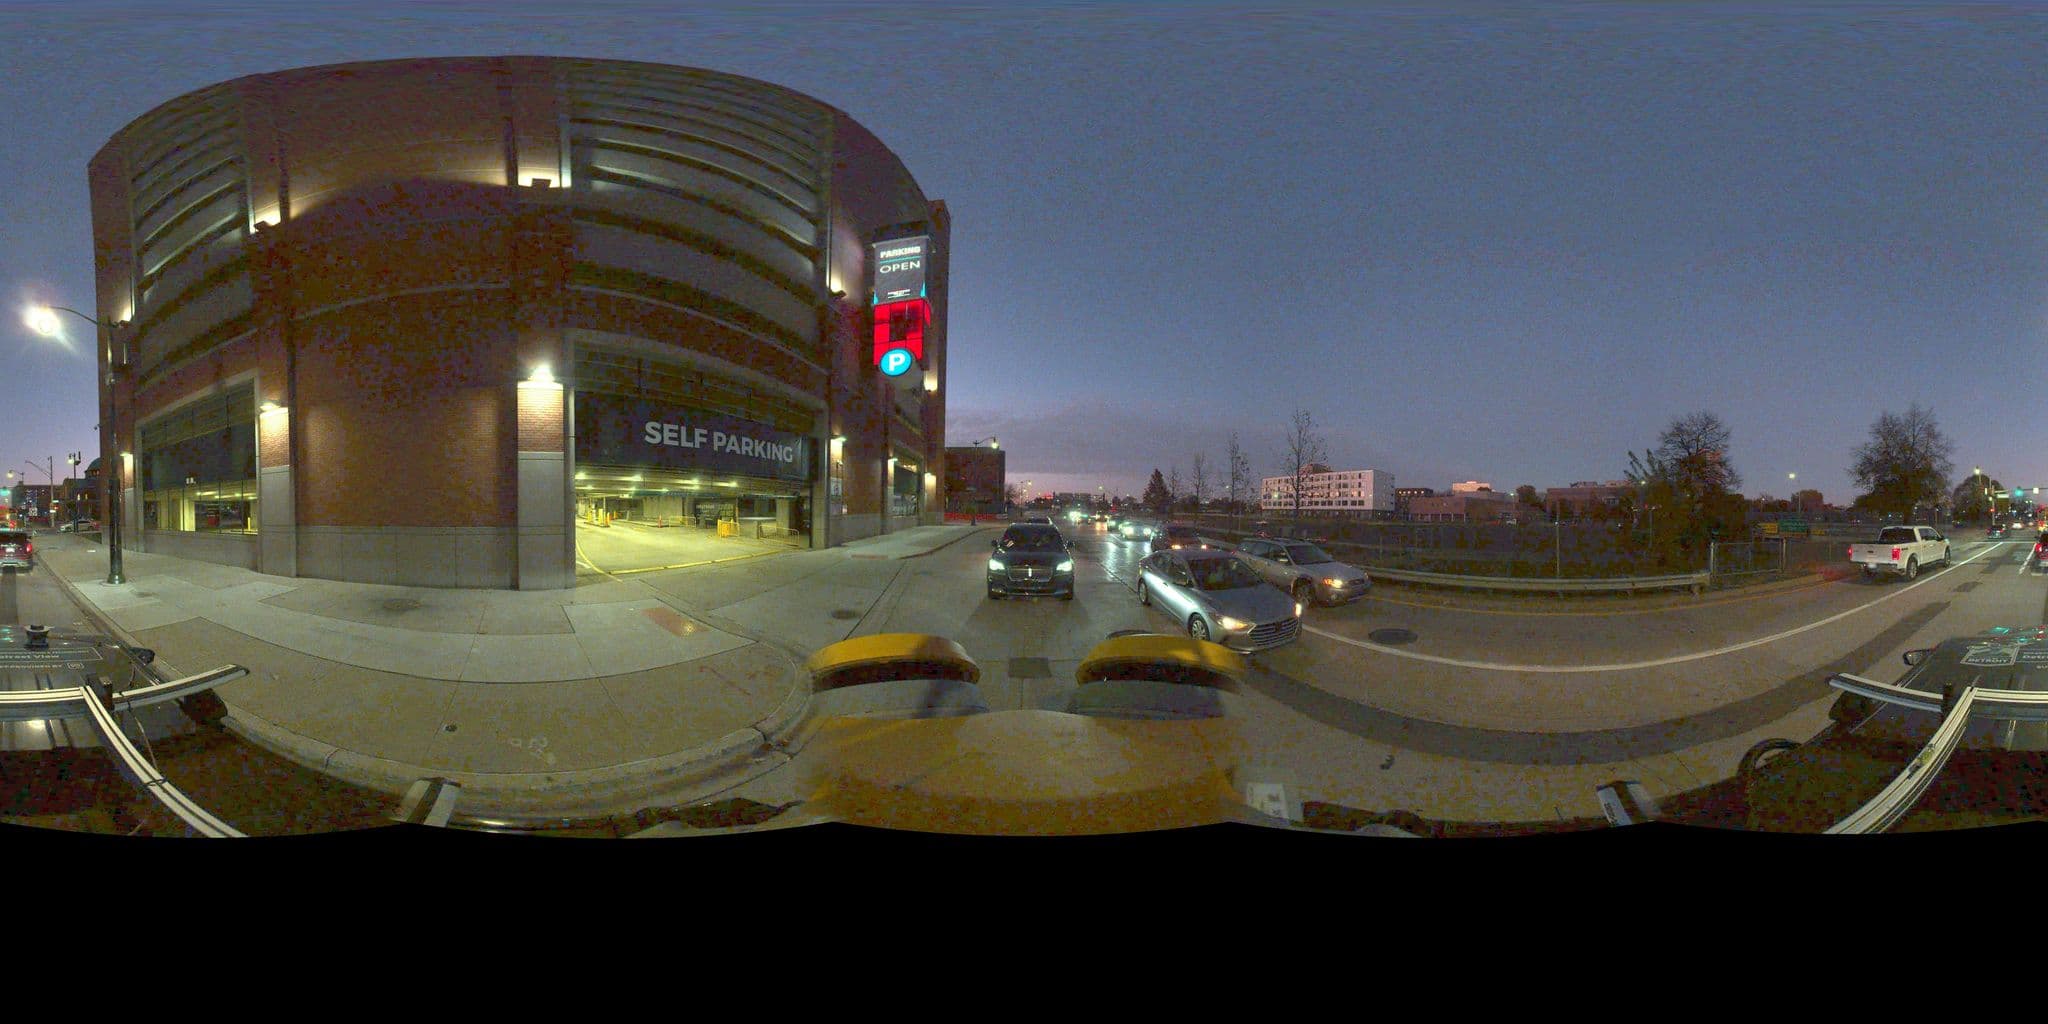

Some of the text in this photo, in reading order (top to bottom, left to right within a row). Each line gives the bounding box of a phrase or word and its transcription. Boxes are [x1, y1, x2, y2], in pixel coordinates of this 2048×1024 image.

[879, 245, 922, 259] PARKING
[879, 260, 921, 274] OPEN
[888, 353, 906, 372] P
[644, 420, 794, 463] SELF PARKING
